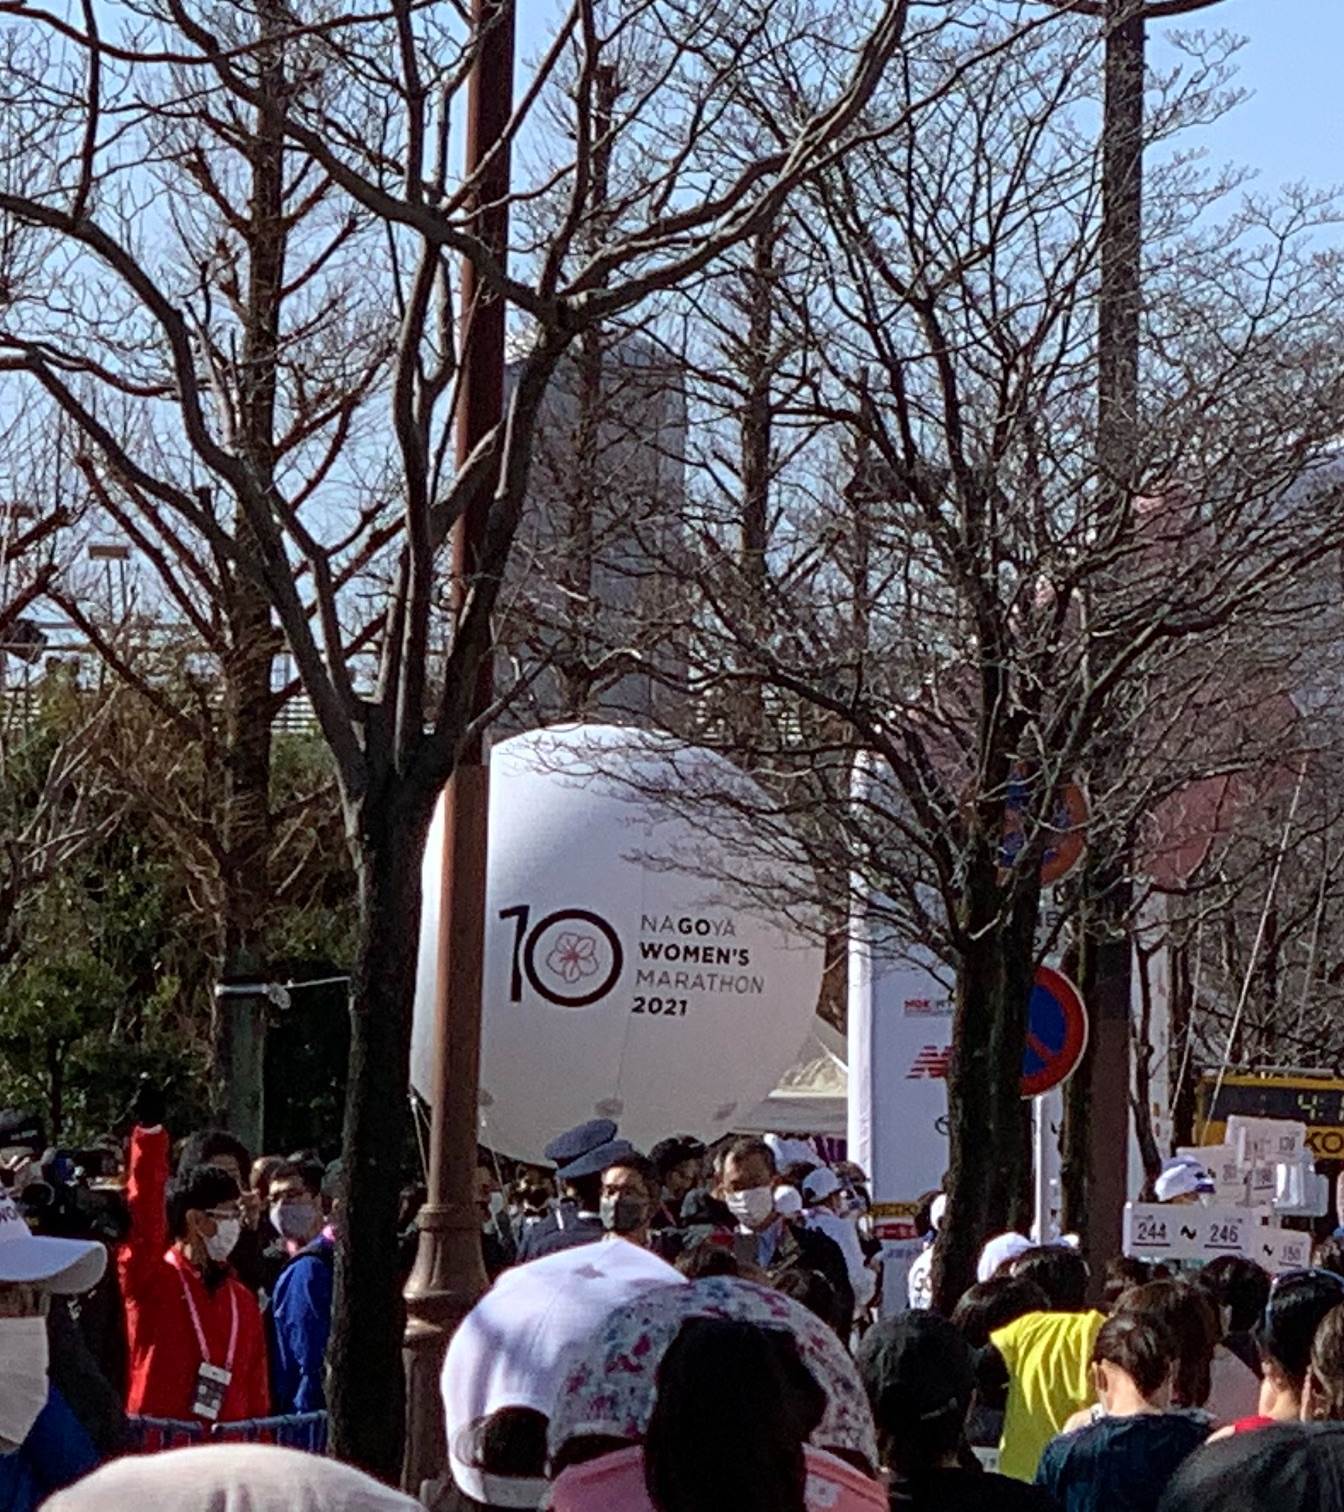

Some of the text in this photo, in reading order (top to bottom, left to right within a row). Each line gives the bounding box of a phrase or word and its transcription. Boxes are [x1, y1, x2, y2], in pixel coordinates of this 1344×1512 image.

[640, 914, 736, 937] NAGOYA
[499, 904, 623, 1008] 10
[639, 942, 750, 967] WOMEN'S
[635, 969, 764, 994] MARATHON
[631, 996, 688, 1016] 2021
[1138, 1223, 1167, 1240] 244
